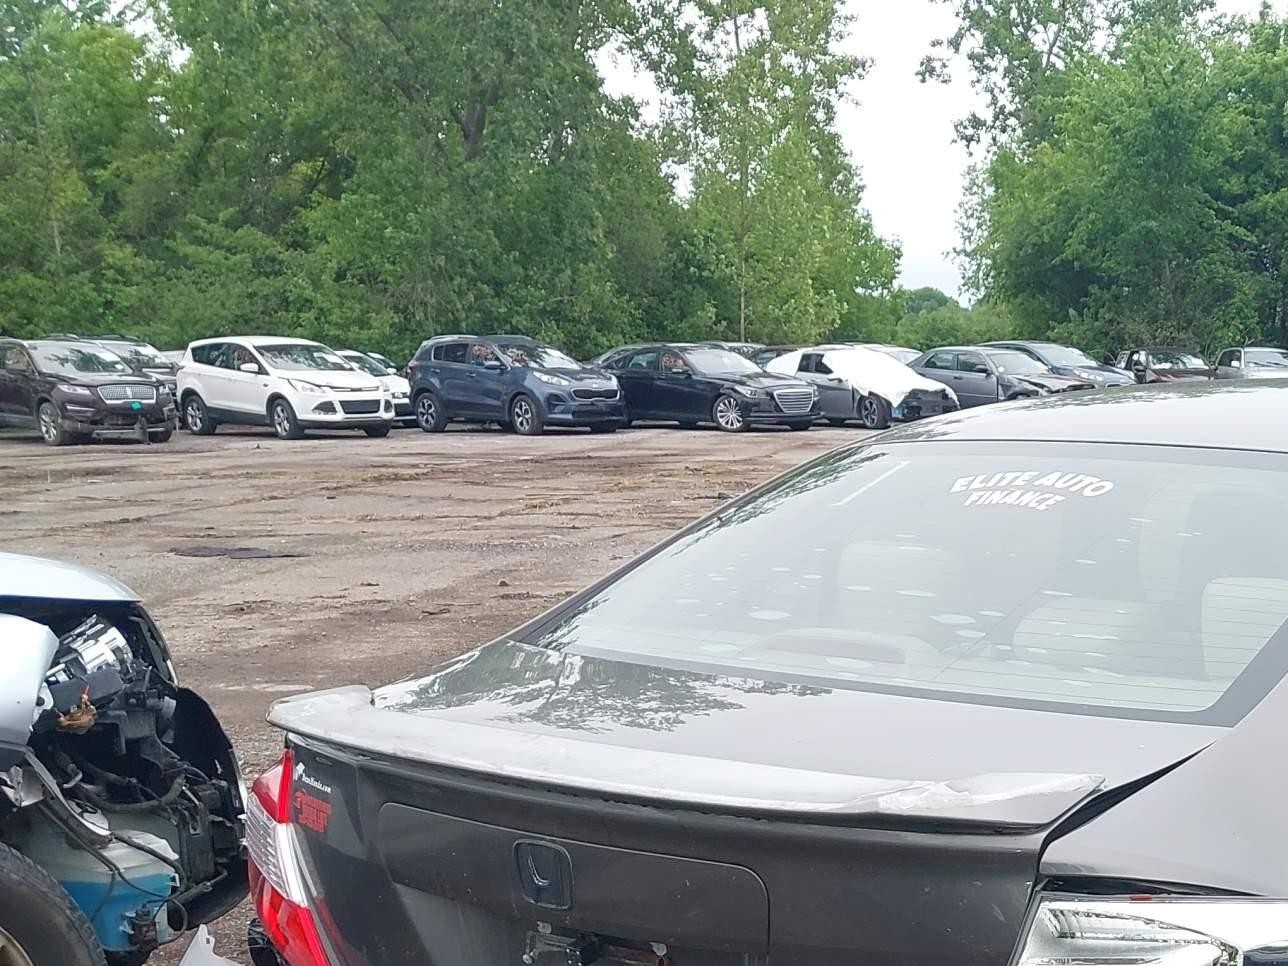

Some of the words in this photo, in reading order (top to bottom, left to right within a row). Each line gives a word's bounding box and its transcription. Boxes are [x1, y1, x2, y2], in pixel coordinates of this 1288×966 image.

[950, 472, 1040, 493] ELITE
[1033, 472, 1114, 497] AUTO
[963, 489, 1066, 511] FINANCE
